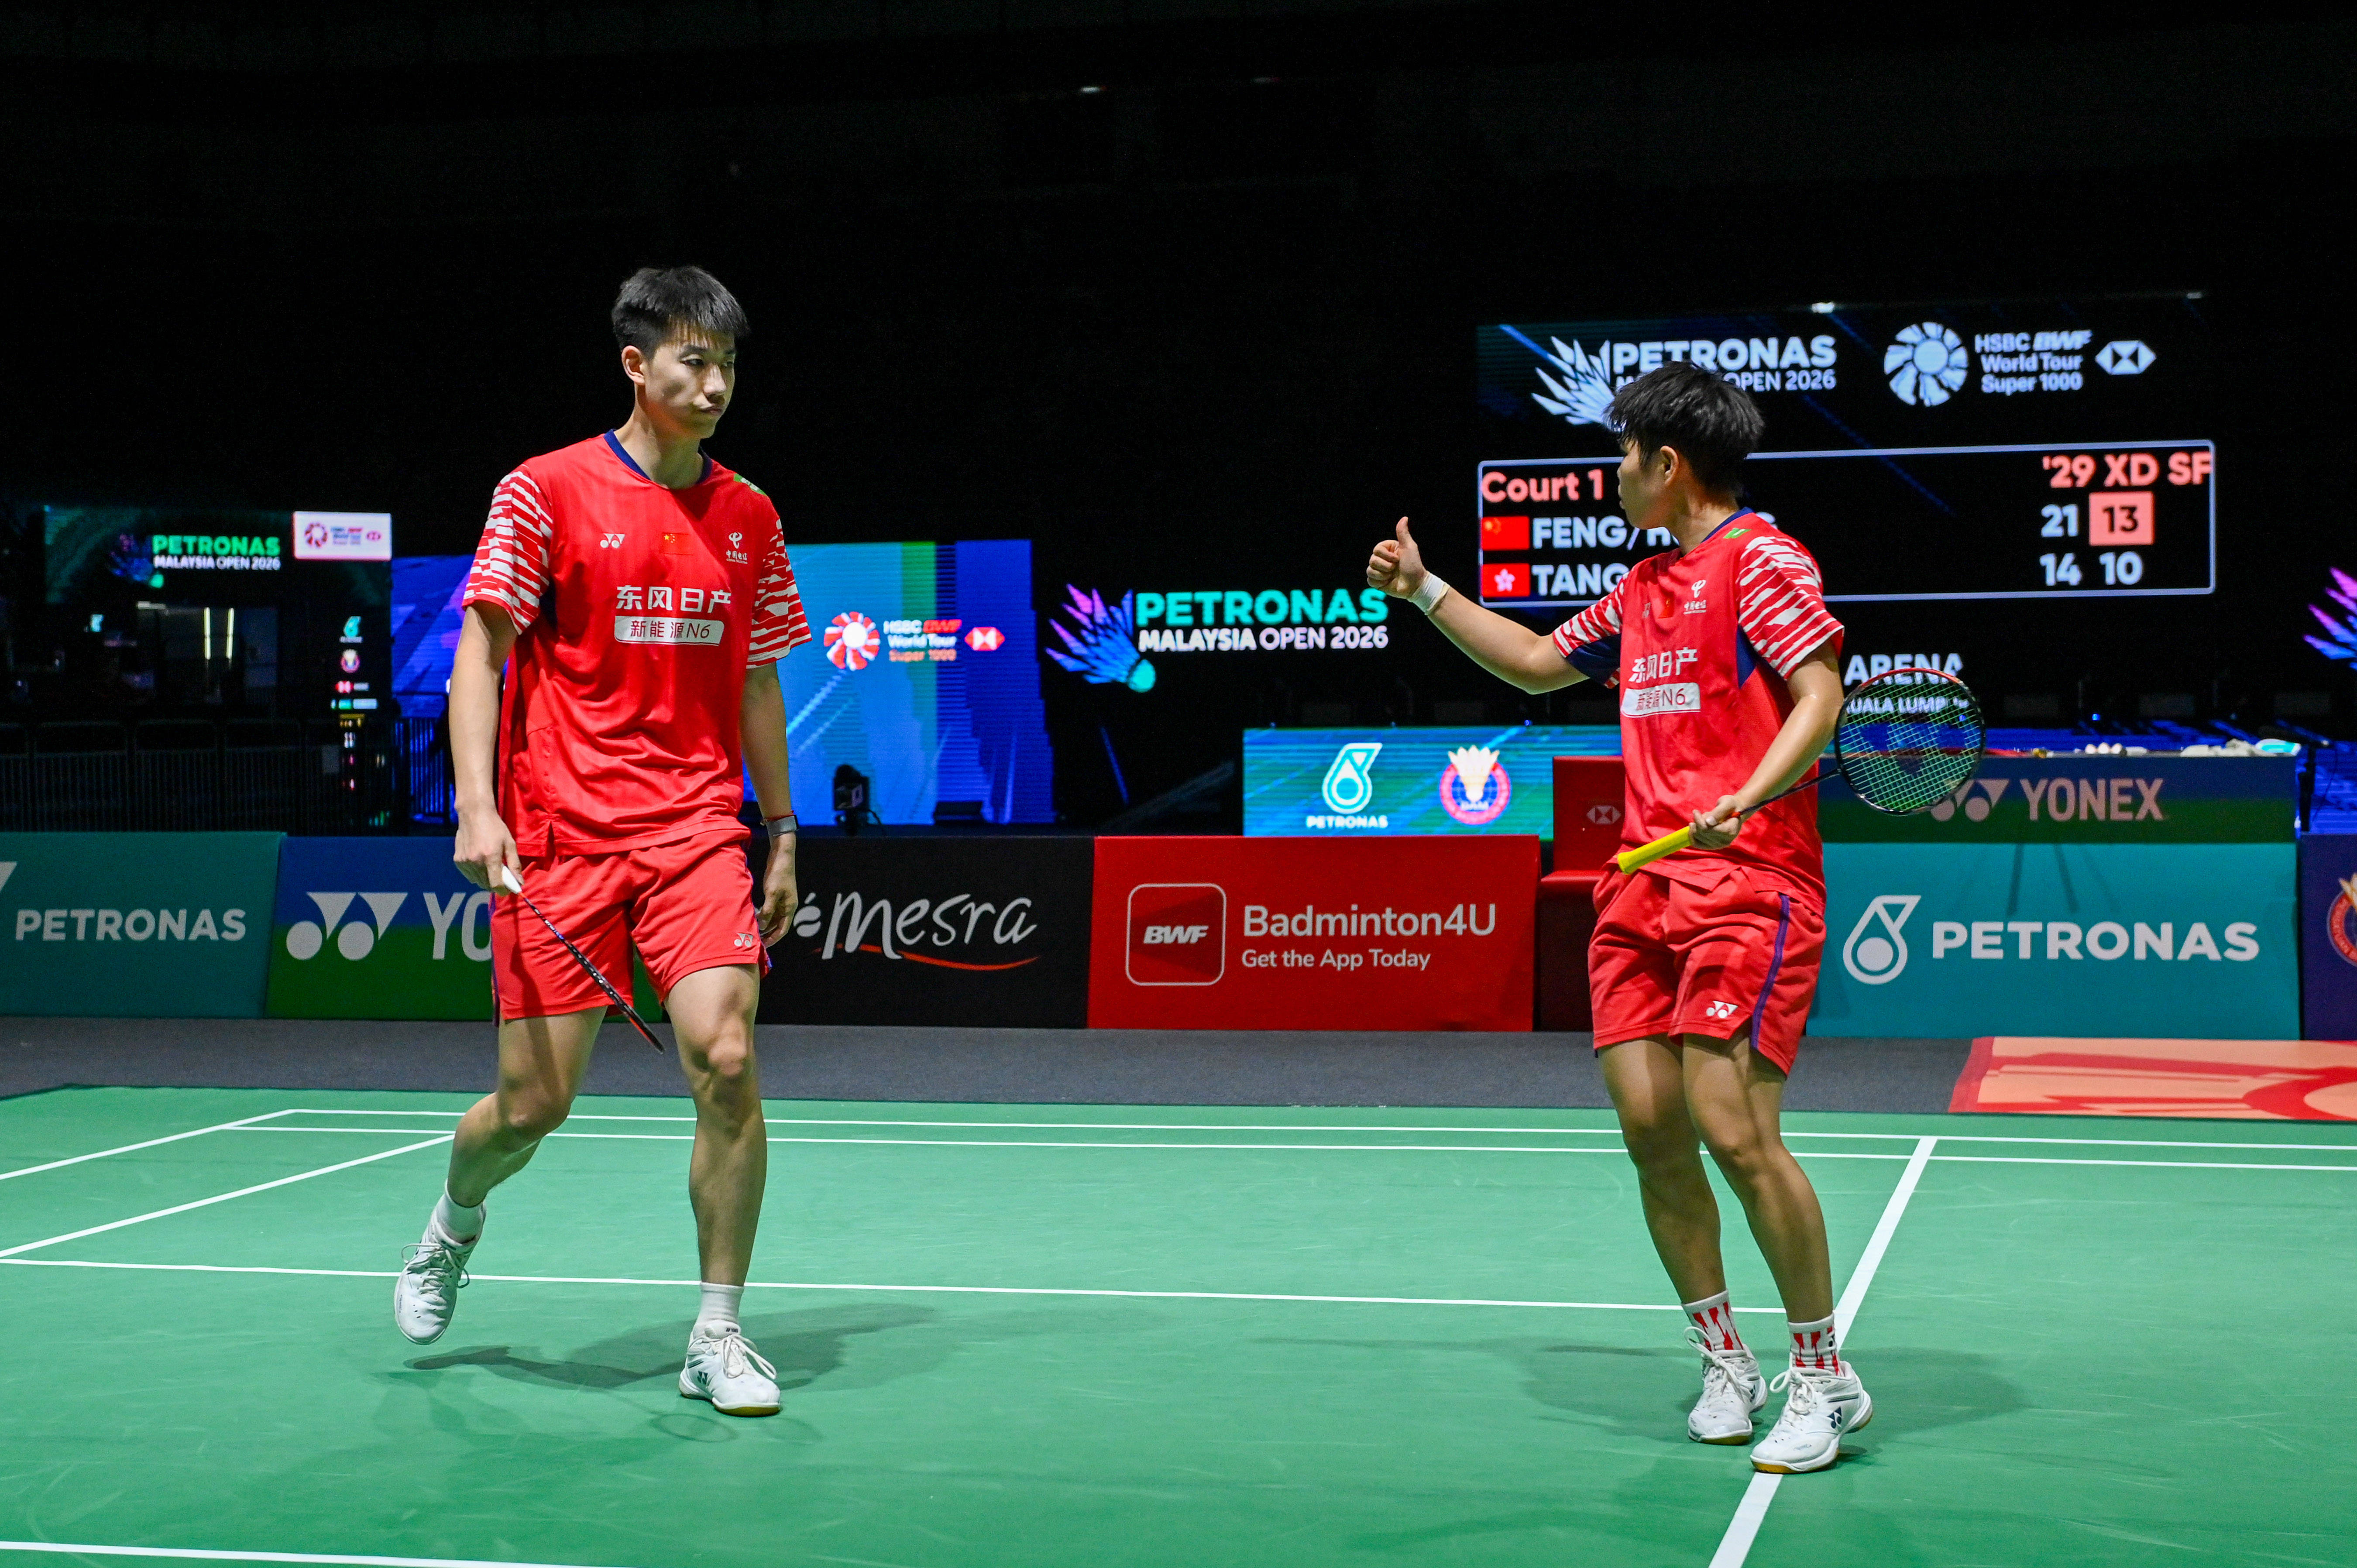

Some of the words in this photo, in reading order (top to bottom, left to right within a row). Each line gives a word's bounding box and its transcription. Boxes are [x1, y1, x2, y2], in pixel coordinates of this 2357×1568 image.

[1613, 335, 1837, 374] PETRONAS
[1974, 332, 2031, 353] HSBC
[1981, 353, 2038, 373] World
[2039, 352, 2083, 371] Tour
[1785, 369, 1837, 391] 2026
[1981, 374, 2037, 396] Super
[2040, 371, 2083, 391] 1000
[2042, 454, 2096, 488] '29
[2104, 453, 2159, 487] XD
[2168, 452, 2212, 485] SF
[1481, 471, 1580, 503] Court
[1587, 468, 1604, 500] 1
[2041, 504, 2079, 538] 21
[2103, 506, 2138, 534] 13
[152, 535, 281, 556] PETRONAS
[153, 555, 214, 569] MALAYSIA
[217, 556, 251, 570] OPEN
[252, 557, 281, 570] 2026
[2040, 553, 2082, 586] 14
[2099, 552, 2143, 585] 10
[616, 585, 732, 613] 东风日产
[1136, 589, 1389, 626] PETRONAS
[630, 620, 710, 638] 新能源N6
[1139, 628, 1257, 652] MALAYSIA
[1259, 627, 1326, 650] OPEN
[1330, 626, 1389, 649] 2026
[1844, 653, 1963, 686] ARENA
[2020, 778, 2164, 821] YONEX
[1306, 815, 1388, 829] PETRONAS
[15, 909, 246, 941] PETRONAS
[1243, 903, 1496, 937] Badminton4U
[1144, 925, 1209, 944] BWF
[1932, 922, 2260, 961] PETRONAS
[1242, 949, 1278, 968] Get
[1282, 948, 1315, 967] the
[1320, 948, 1364, 971] App
[1369, 948, 1431, 970] Today
